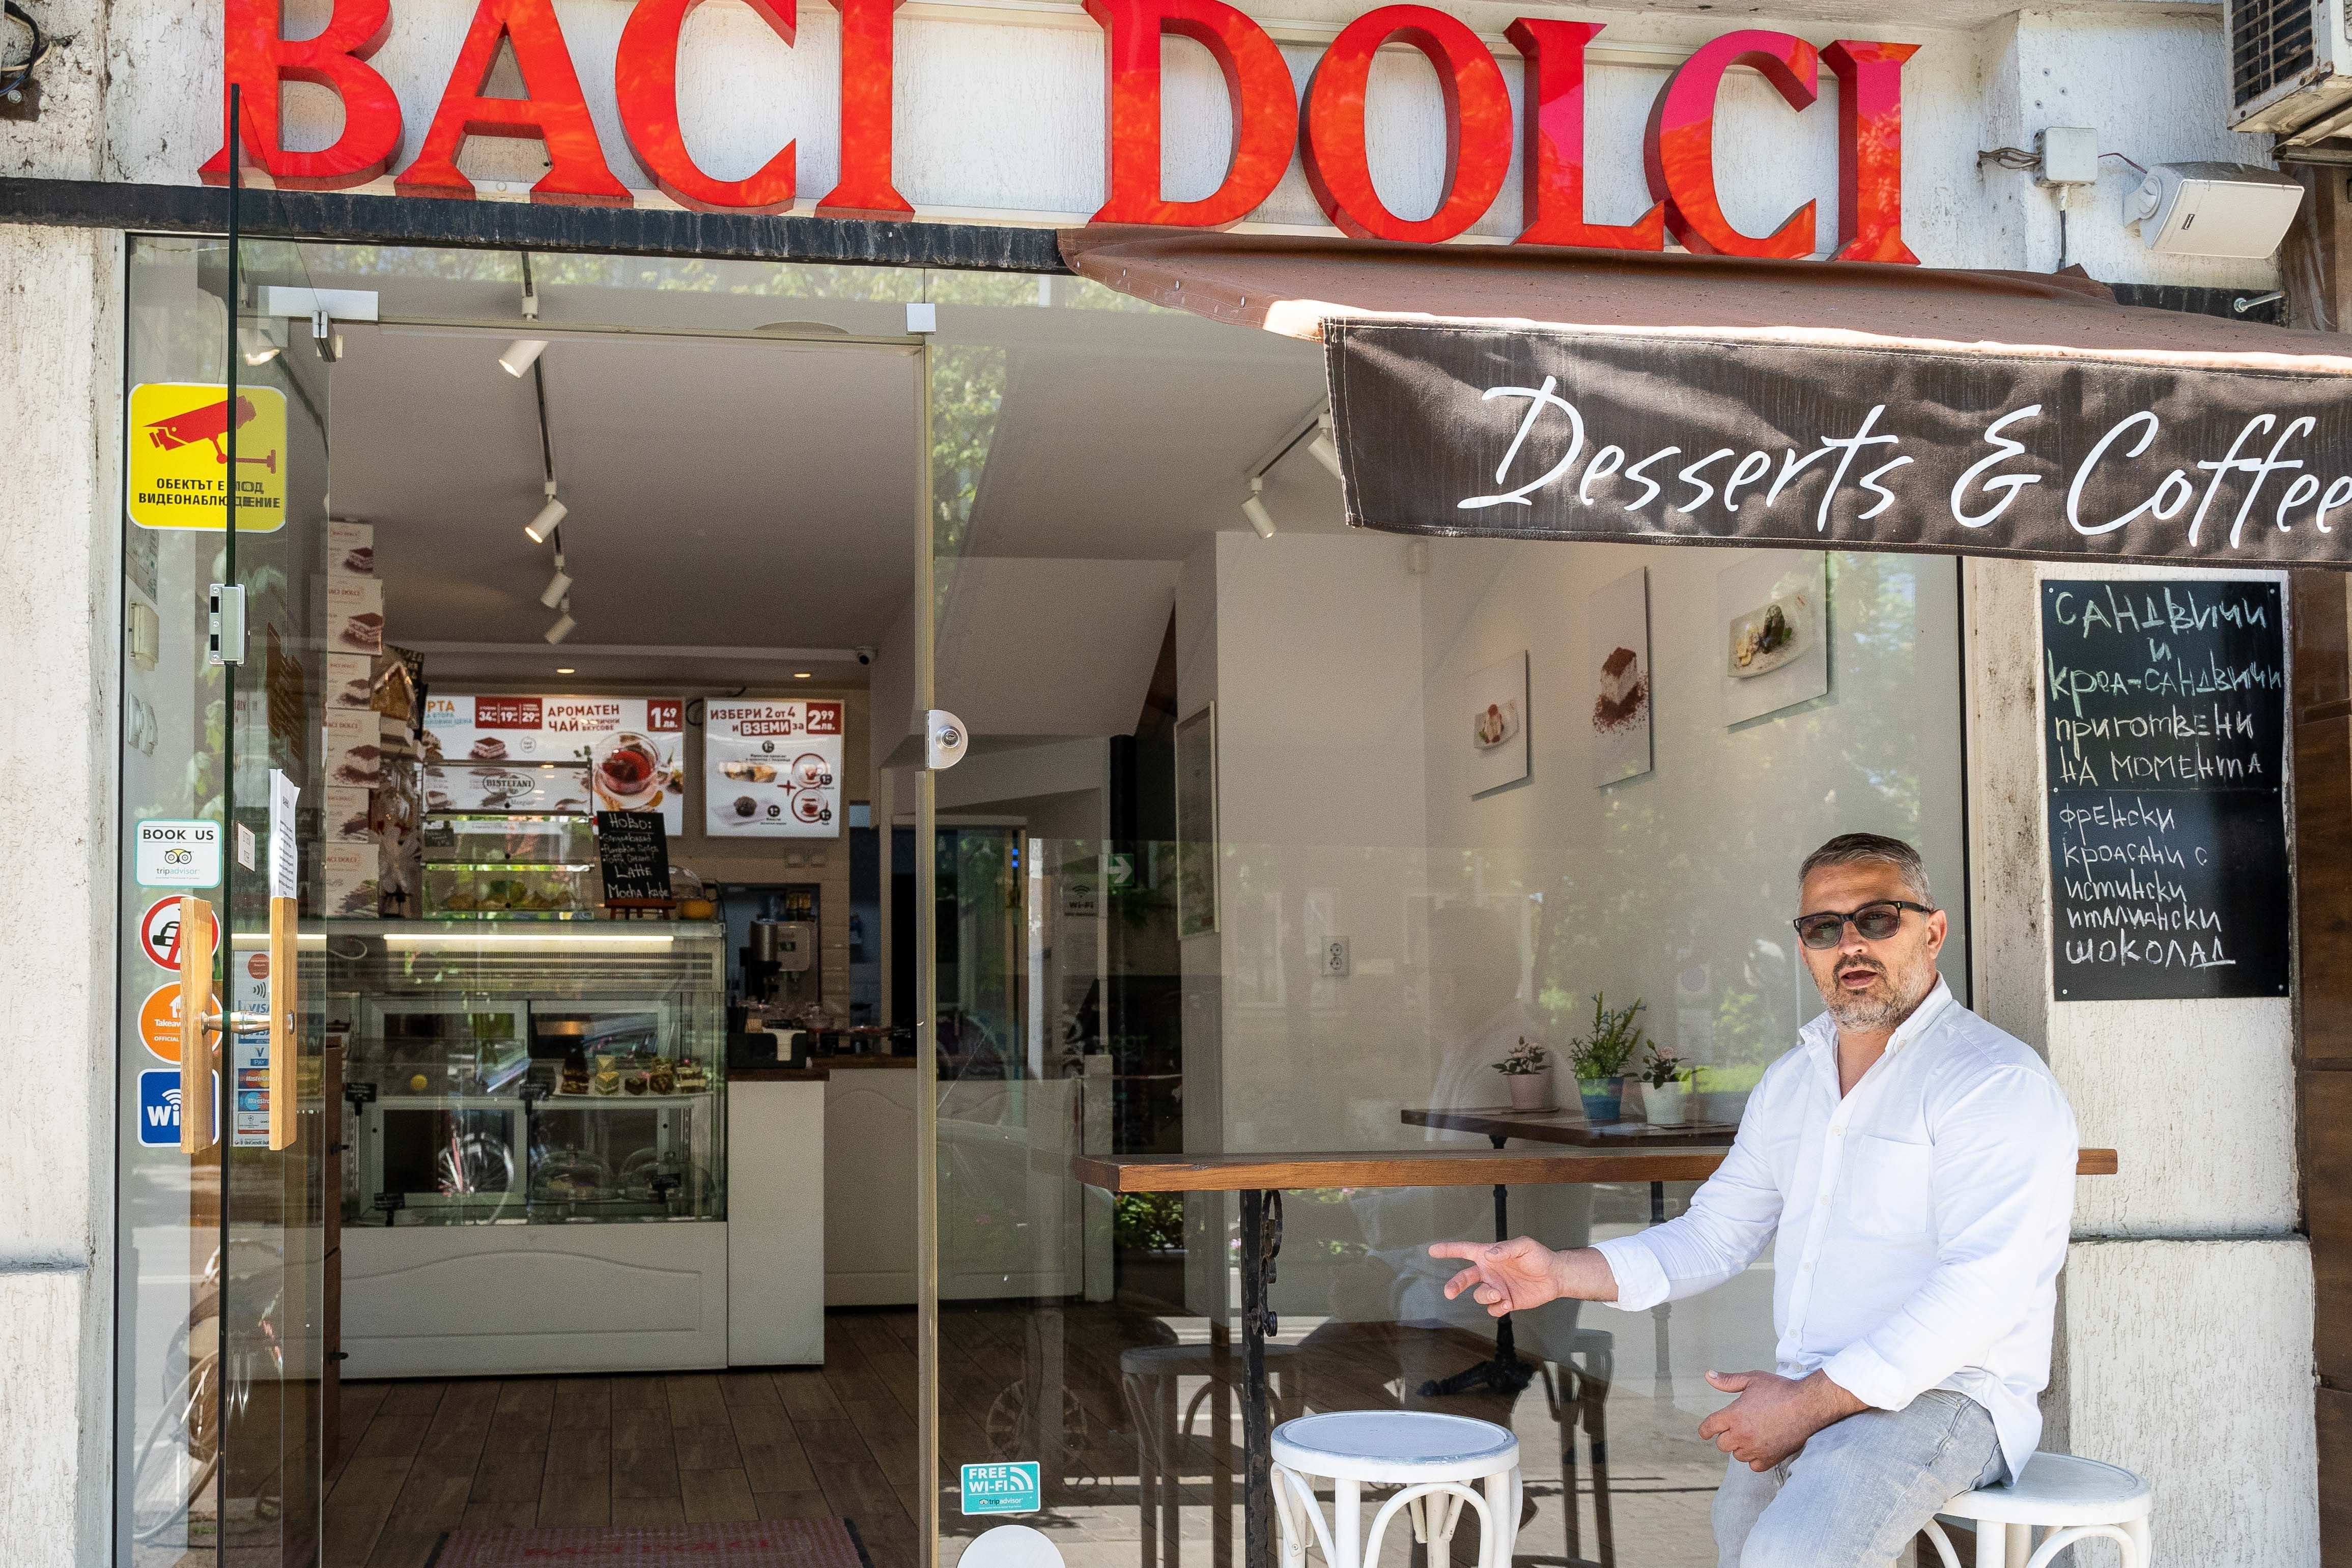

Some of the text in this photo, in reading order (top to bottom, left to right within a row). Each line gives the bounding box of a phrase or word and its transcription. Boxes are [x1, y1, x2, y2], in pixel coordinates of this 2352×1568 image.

[197, 0, 1922, 266] BACI DOLCI
[1457, 375, 2352, 549] Desserts & Coffee
[156, 478, 213, 490] ОБЕКТЪТ
[217, 480, 224, 491] Е
[548, 704, 619, 717] АРОМАТЕН
[710, 708, 762, 720] ИЗБЕРИ
[765, 707, 773, 718] 2
[549, 718, 579, 731] ЧАЙ
[742, 721, 789, 735] ВЗЕМИ
[143, 829, 214, 840] BOOK US
[157, 867, 198, 876] tripadvisor
[969, 1467, 1007, 1479] FREE
[969, 1480, 1008, 1493] WI-FI
